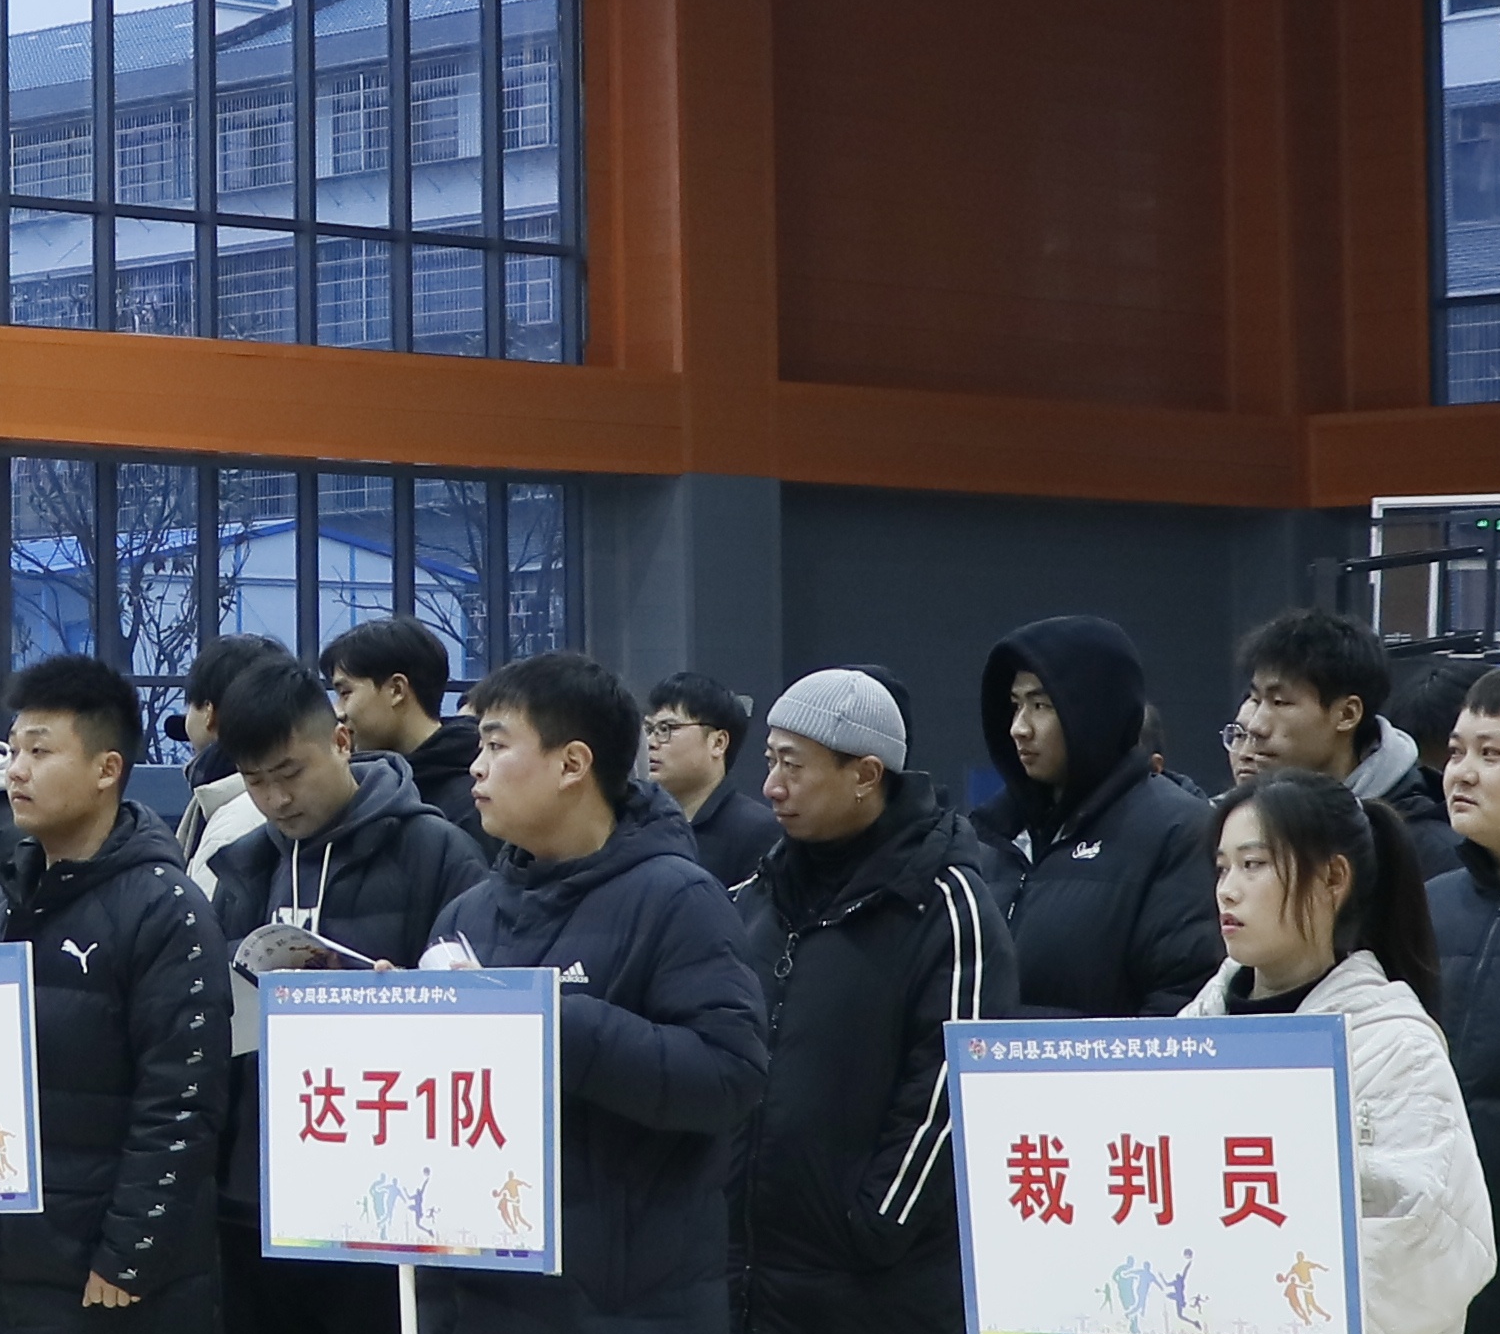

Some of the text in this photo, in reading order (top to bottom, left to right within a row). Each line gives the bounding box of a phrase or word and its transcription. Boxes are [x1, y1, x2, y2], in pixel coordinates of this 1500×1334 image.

[990, 1036, 1217, 1061] 会同县五环时代全民健身中心
[298, 1067, 507, 1150] 达子1队
[1006, 1133, 1288, 1229] 裁判员
